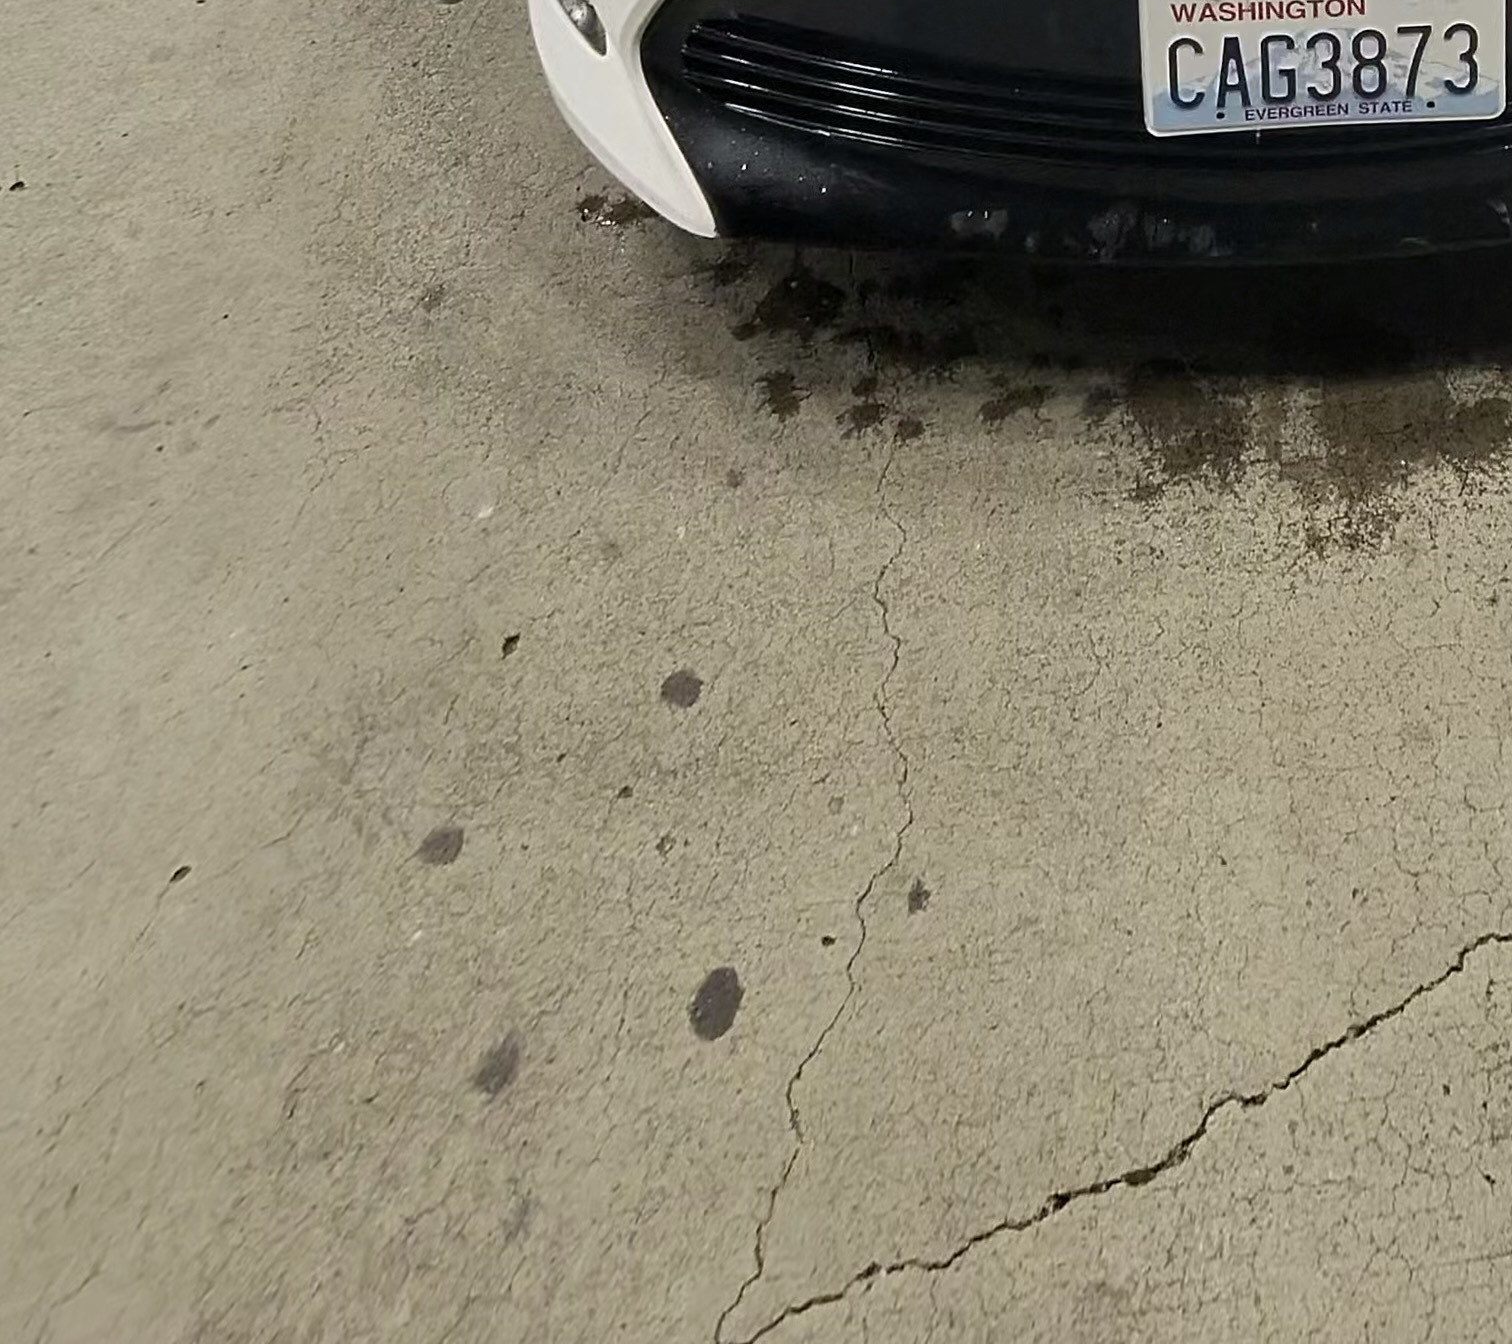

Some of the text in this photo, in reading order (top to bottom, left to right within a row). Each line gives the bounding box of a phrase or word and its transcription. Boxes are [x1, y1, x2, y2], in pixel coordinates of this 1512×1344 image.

[1168, 23, 1480, 110] CAG3873
[1244, 99, 1414, 122] EVERGREEN STATE
